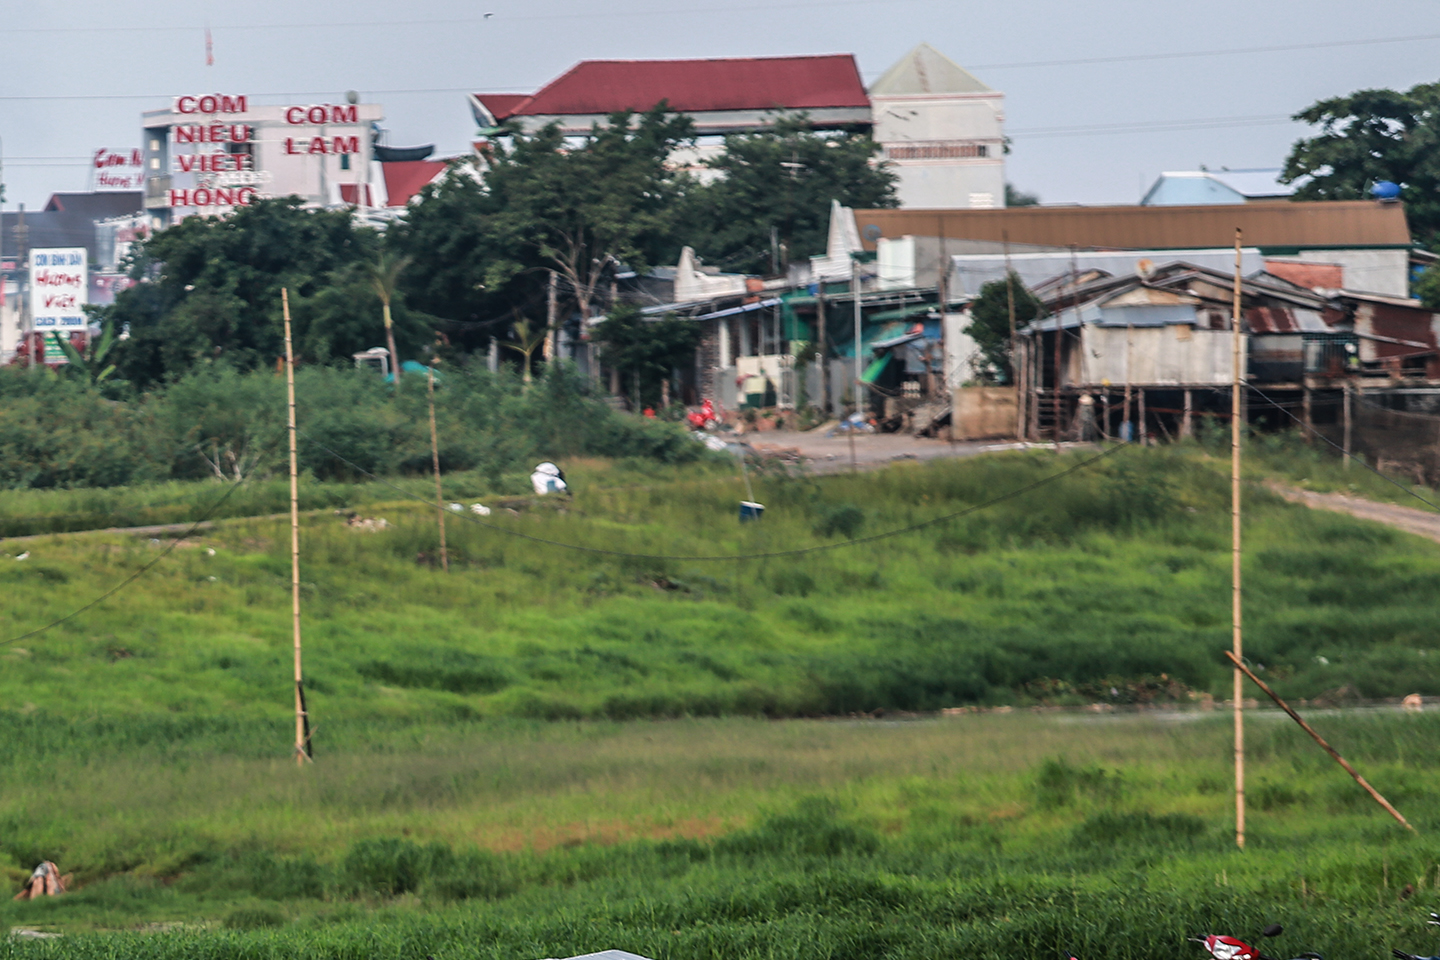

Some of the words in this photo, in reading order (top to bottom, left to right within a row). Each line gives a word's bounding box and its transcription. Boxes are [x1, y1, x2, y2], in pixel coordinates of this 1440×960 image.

[178, 93, 247, 114] CƠM
[286, 103, 358, 125] CƠM
[286, 136, 359, 155] LAM
